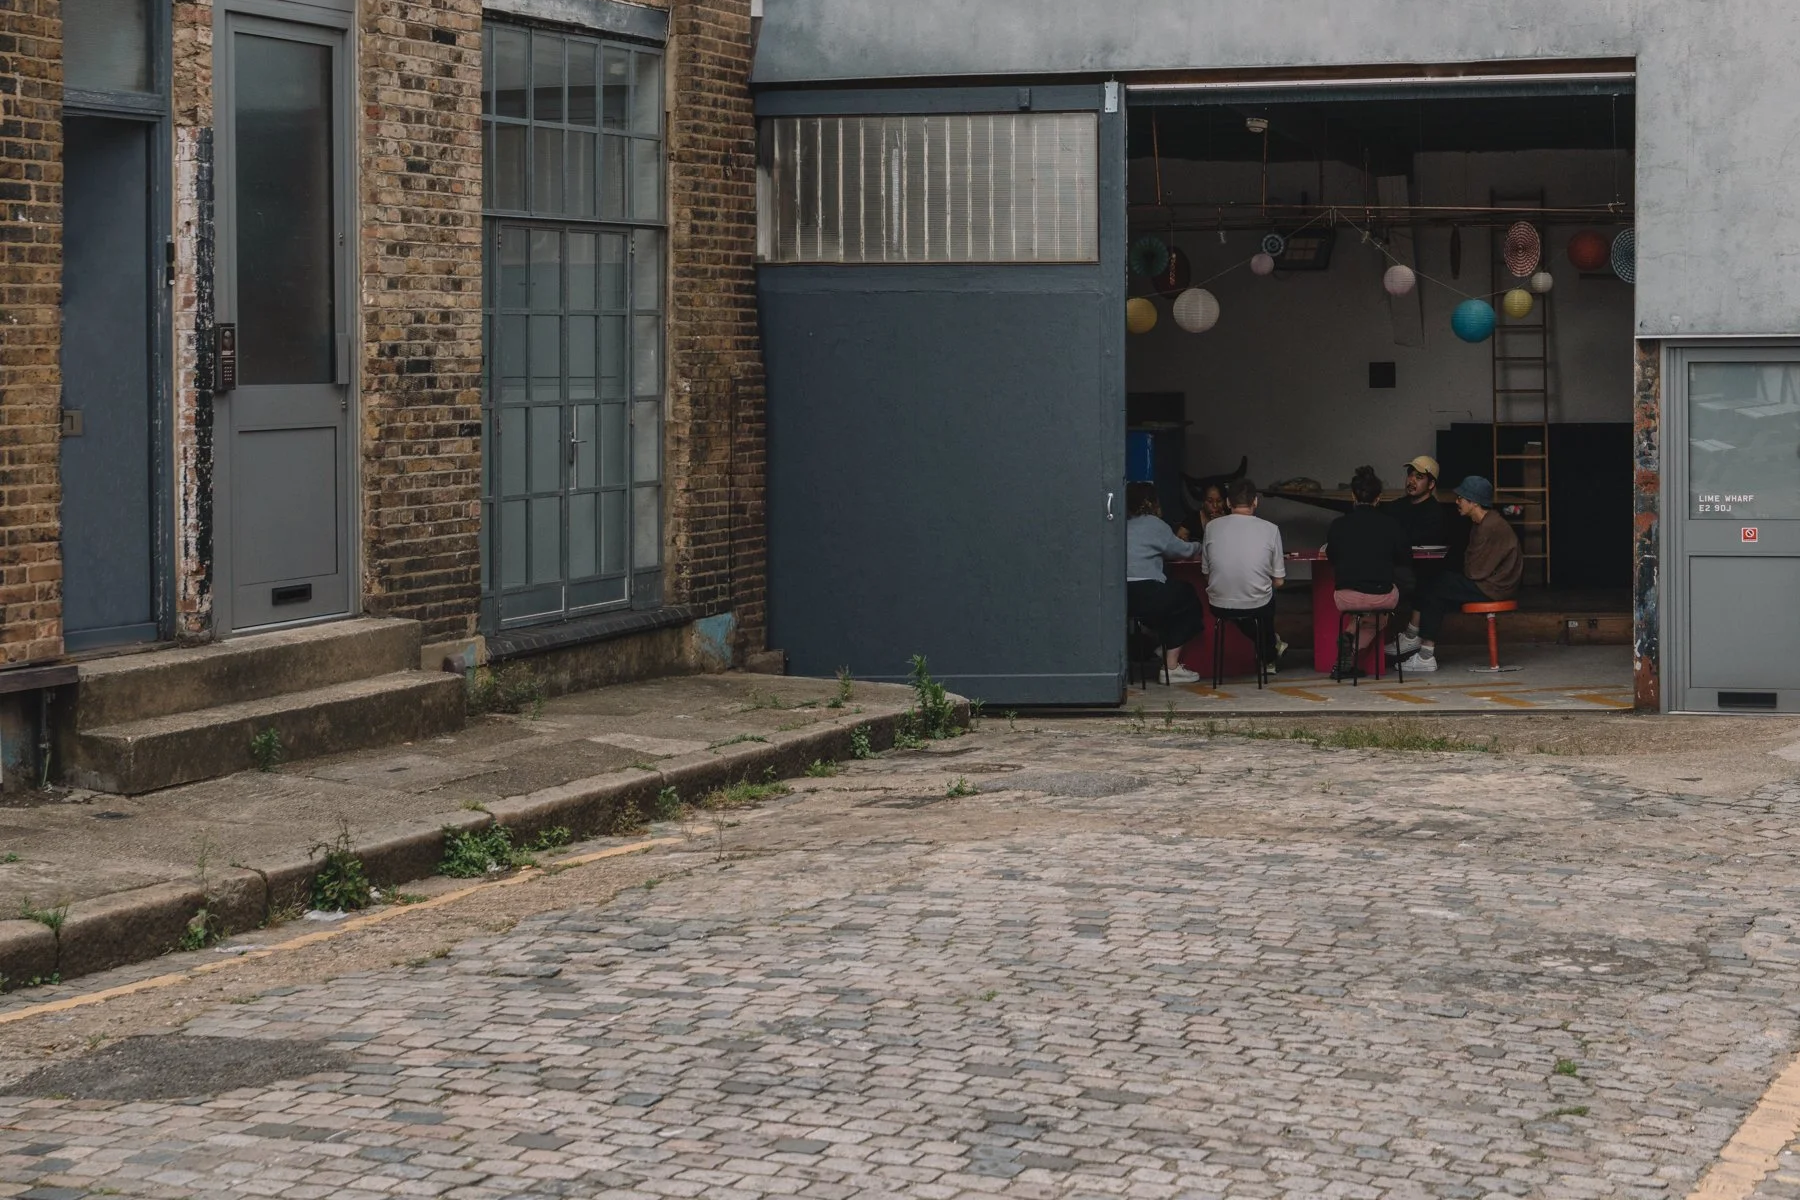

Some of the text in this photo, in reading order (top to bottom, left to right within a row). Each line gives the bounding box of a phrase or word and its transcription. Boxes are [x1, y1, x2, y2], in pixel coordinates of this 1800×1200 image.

[1698, 494, 1755, 502] LIME WHARF
[1698, 504, 1711, 512] E2
